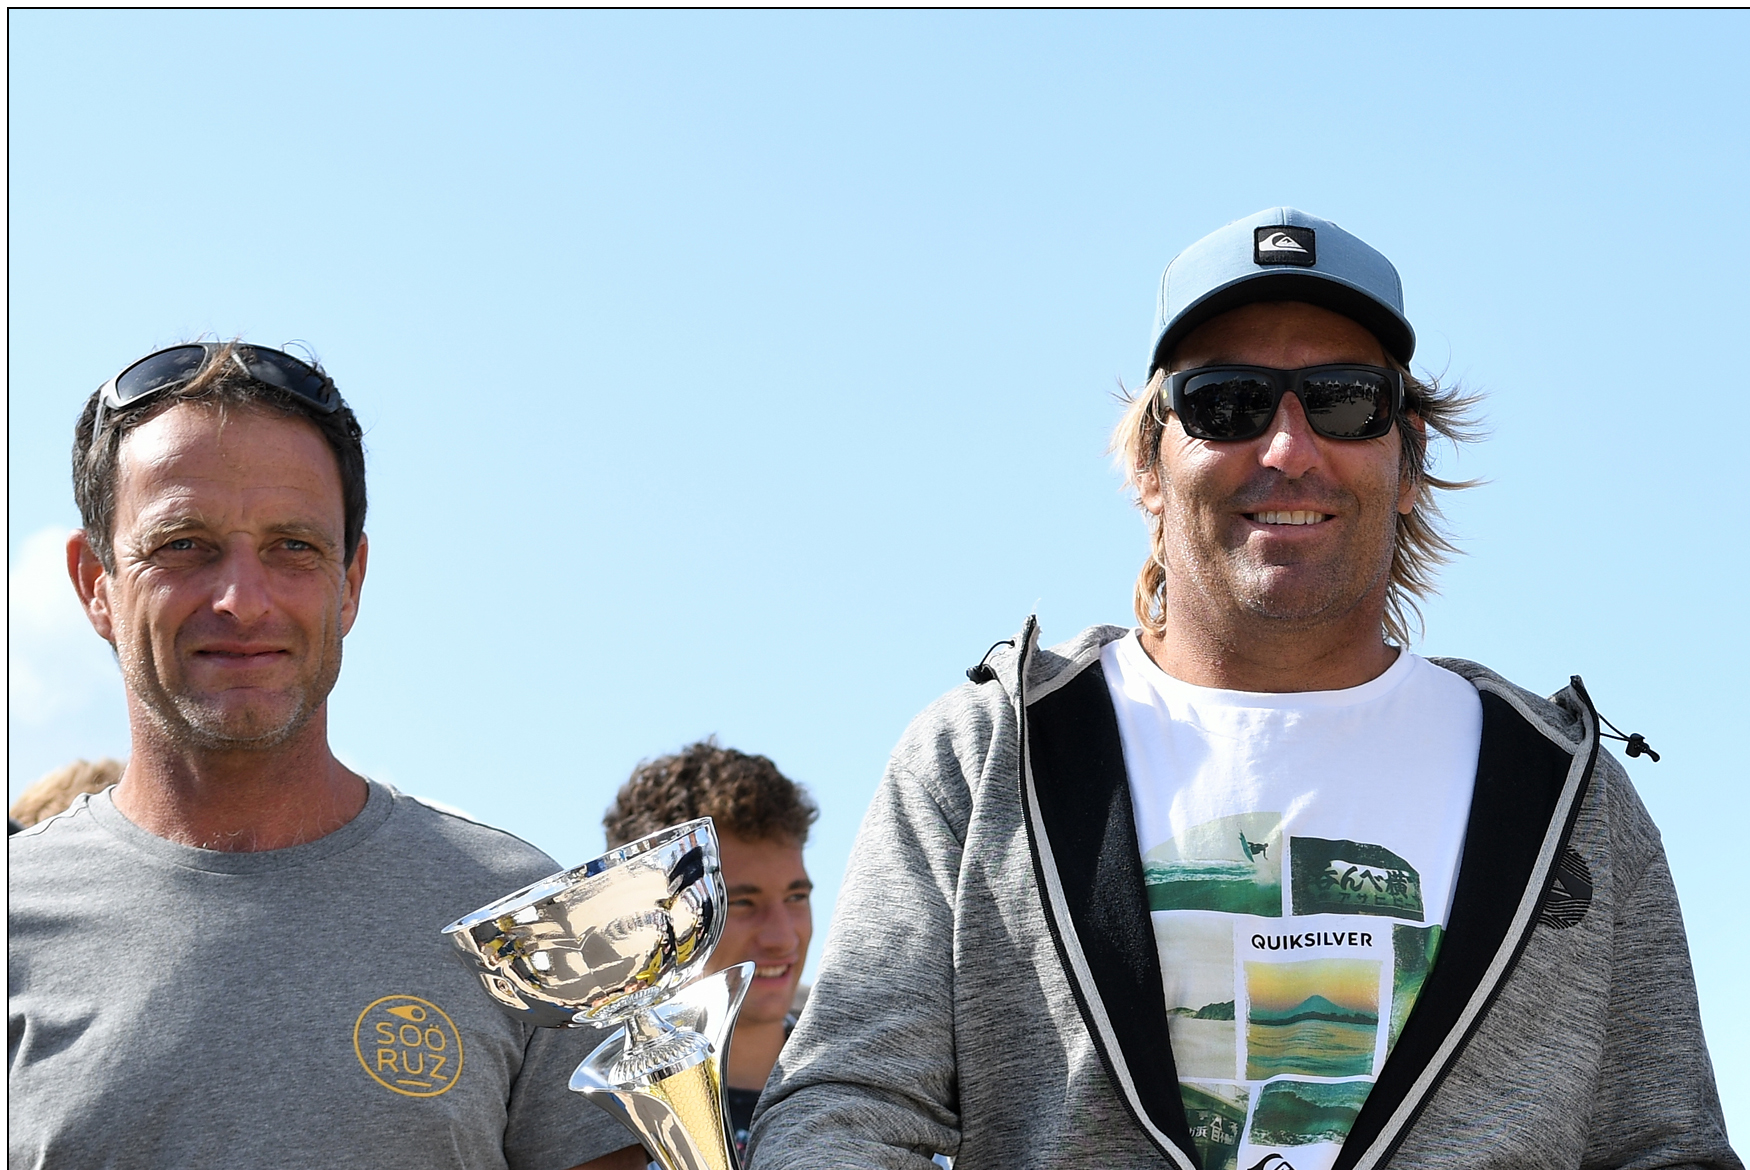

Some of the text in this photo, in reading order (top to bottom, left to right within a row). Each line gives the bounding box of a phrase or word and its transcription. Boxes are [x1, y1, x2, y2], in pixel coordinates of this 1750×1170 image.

[1251, 931, 1373, 951] QUIKSILVER
[376, 1022, 447, 1052] SOÖ
[377, 1048, 448, 1080] RUZ
